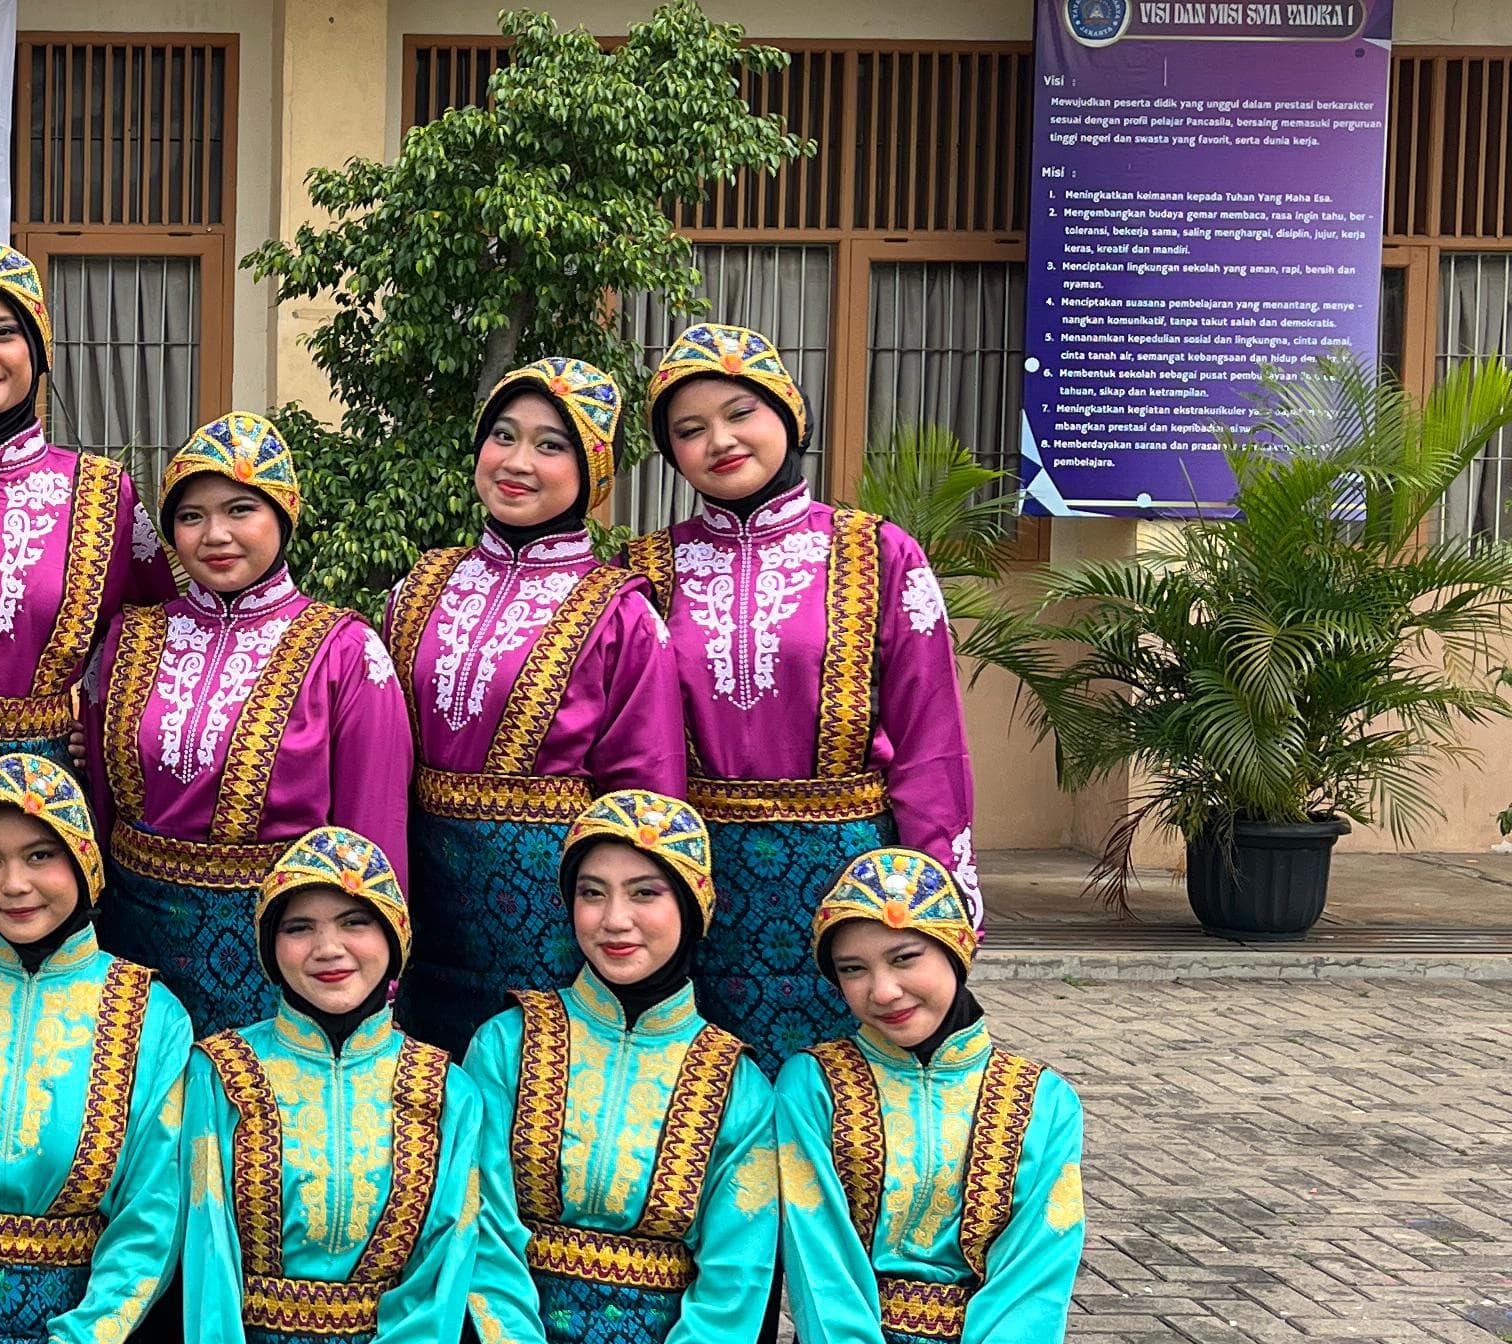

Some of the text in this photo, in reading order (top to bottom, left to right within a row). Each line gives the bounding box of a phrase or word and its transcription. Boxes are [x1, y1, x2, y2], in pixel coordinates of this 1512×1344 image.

[1140, 3, 1170, 23] VISI
[1174, 3, 1206, 24] DAN
[1210, 4, 1242, 24] MISI
[1247, 4, 1282, 24] SMA
[1287, 4, 1343, 25] YADIKA
[1043, 75, 1064, 86] Visi
[1051, 97, 1374, 112] Mewujudkan peserta didik yang unggul dalam prestasi berkarakter
[1050, 115, 1082, 124] sesuai
[1084, 115, 1121, 128] dengan
[1150, 116, 1184, 127] pelajar
[1186, 117, 1234, 128] Pancasila,
[1236, 117, 1279, 131] bersaing
[1281, 118, 1330, 128] memasuki
[1333, 120, 1382, 131] perguruan
[1050, 132, 1290, 147] tinggi negeri dan swasta yang serta dunia
[1042, 166, 1065, 178] Misi
[1065, 190, 1333, 205] Meningkatkan kepada Tuhan Yang Maha Esa.
[1064, 208, 1146, 221] Mengembangkan
[1148, 209, 1184, 220] budaya
[1186, 211, 1218, 222] gemar
[1220, 210, 1269, 221] membaca,
[1295, 211, 1319, 224] ingin
[1349, 212, 1366, 221] ber
[1065, 225, 1365, 241] toleransi, bekerja sama, saling menghargai, kerja
[1064, 243, 1150, 254] keras, kreatif dan
[1062, 261, 1356, 277] Menciptakan lingkungan sekolah yang aman, bersih dan
[1063, 281, 1104, 291] nyaman.
[1061, 297, 1355, 313] Menciptakan suasana pembelajaran yang menye
[1062, 315, 1337, 328] nangkan tanpa takut salah dan demokratis.
[1060, 333, 1352, 348] Menanamkan kepedulian sosial dan lingkungna, cinta damai,
[1060, 350, 1267, 365] cinta tanah semangat kebangsaan dan
[1059, 368, 1228, 383] Membentuk sekolah sebagai pusat
[1059, 386, 1209, 399] tahuan, sikap dan ketrampilan.
[1056, 403, 1171, 418] Meningkatkan kegiatan
[1054, 421, 1168, 435] mbangkan prestasi dan
[1053, 439, 1189, 451] Memberdayakan sarana dan
[1053, 457, 1115, 469] pembelajara.
